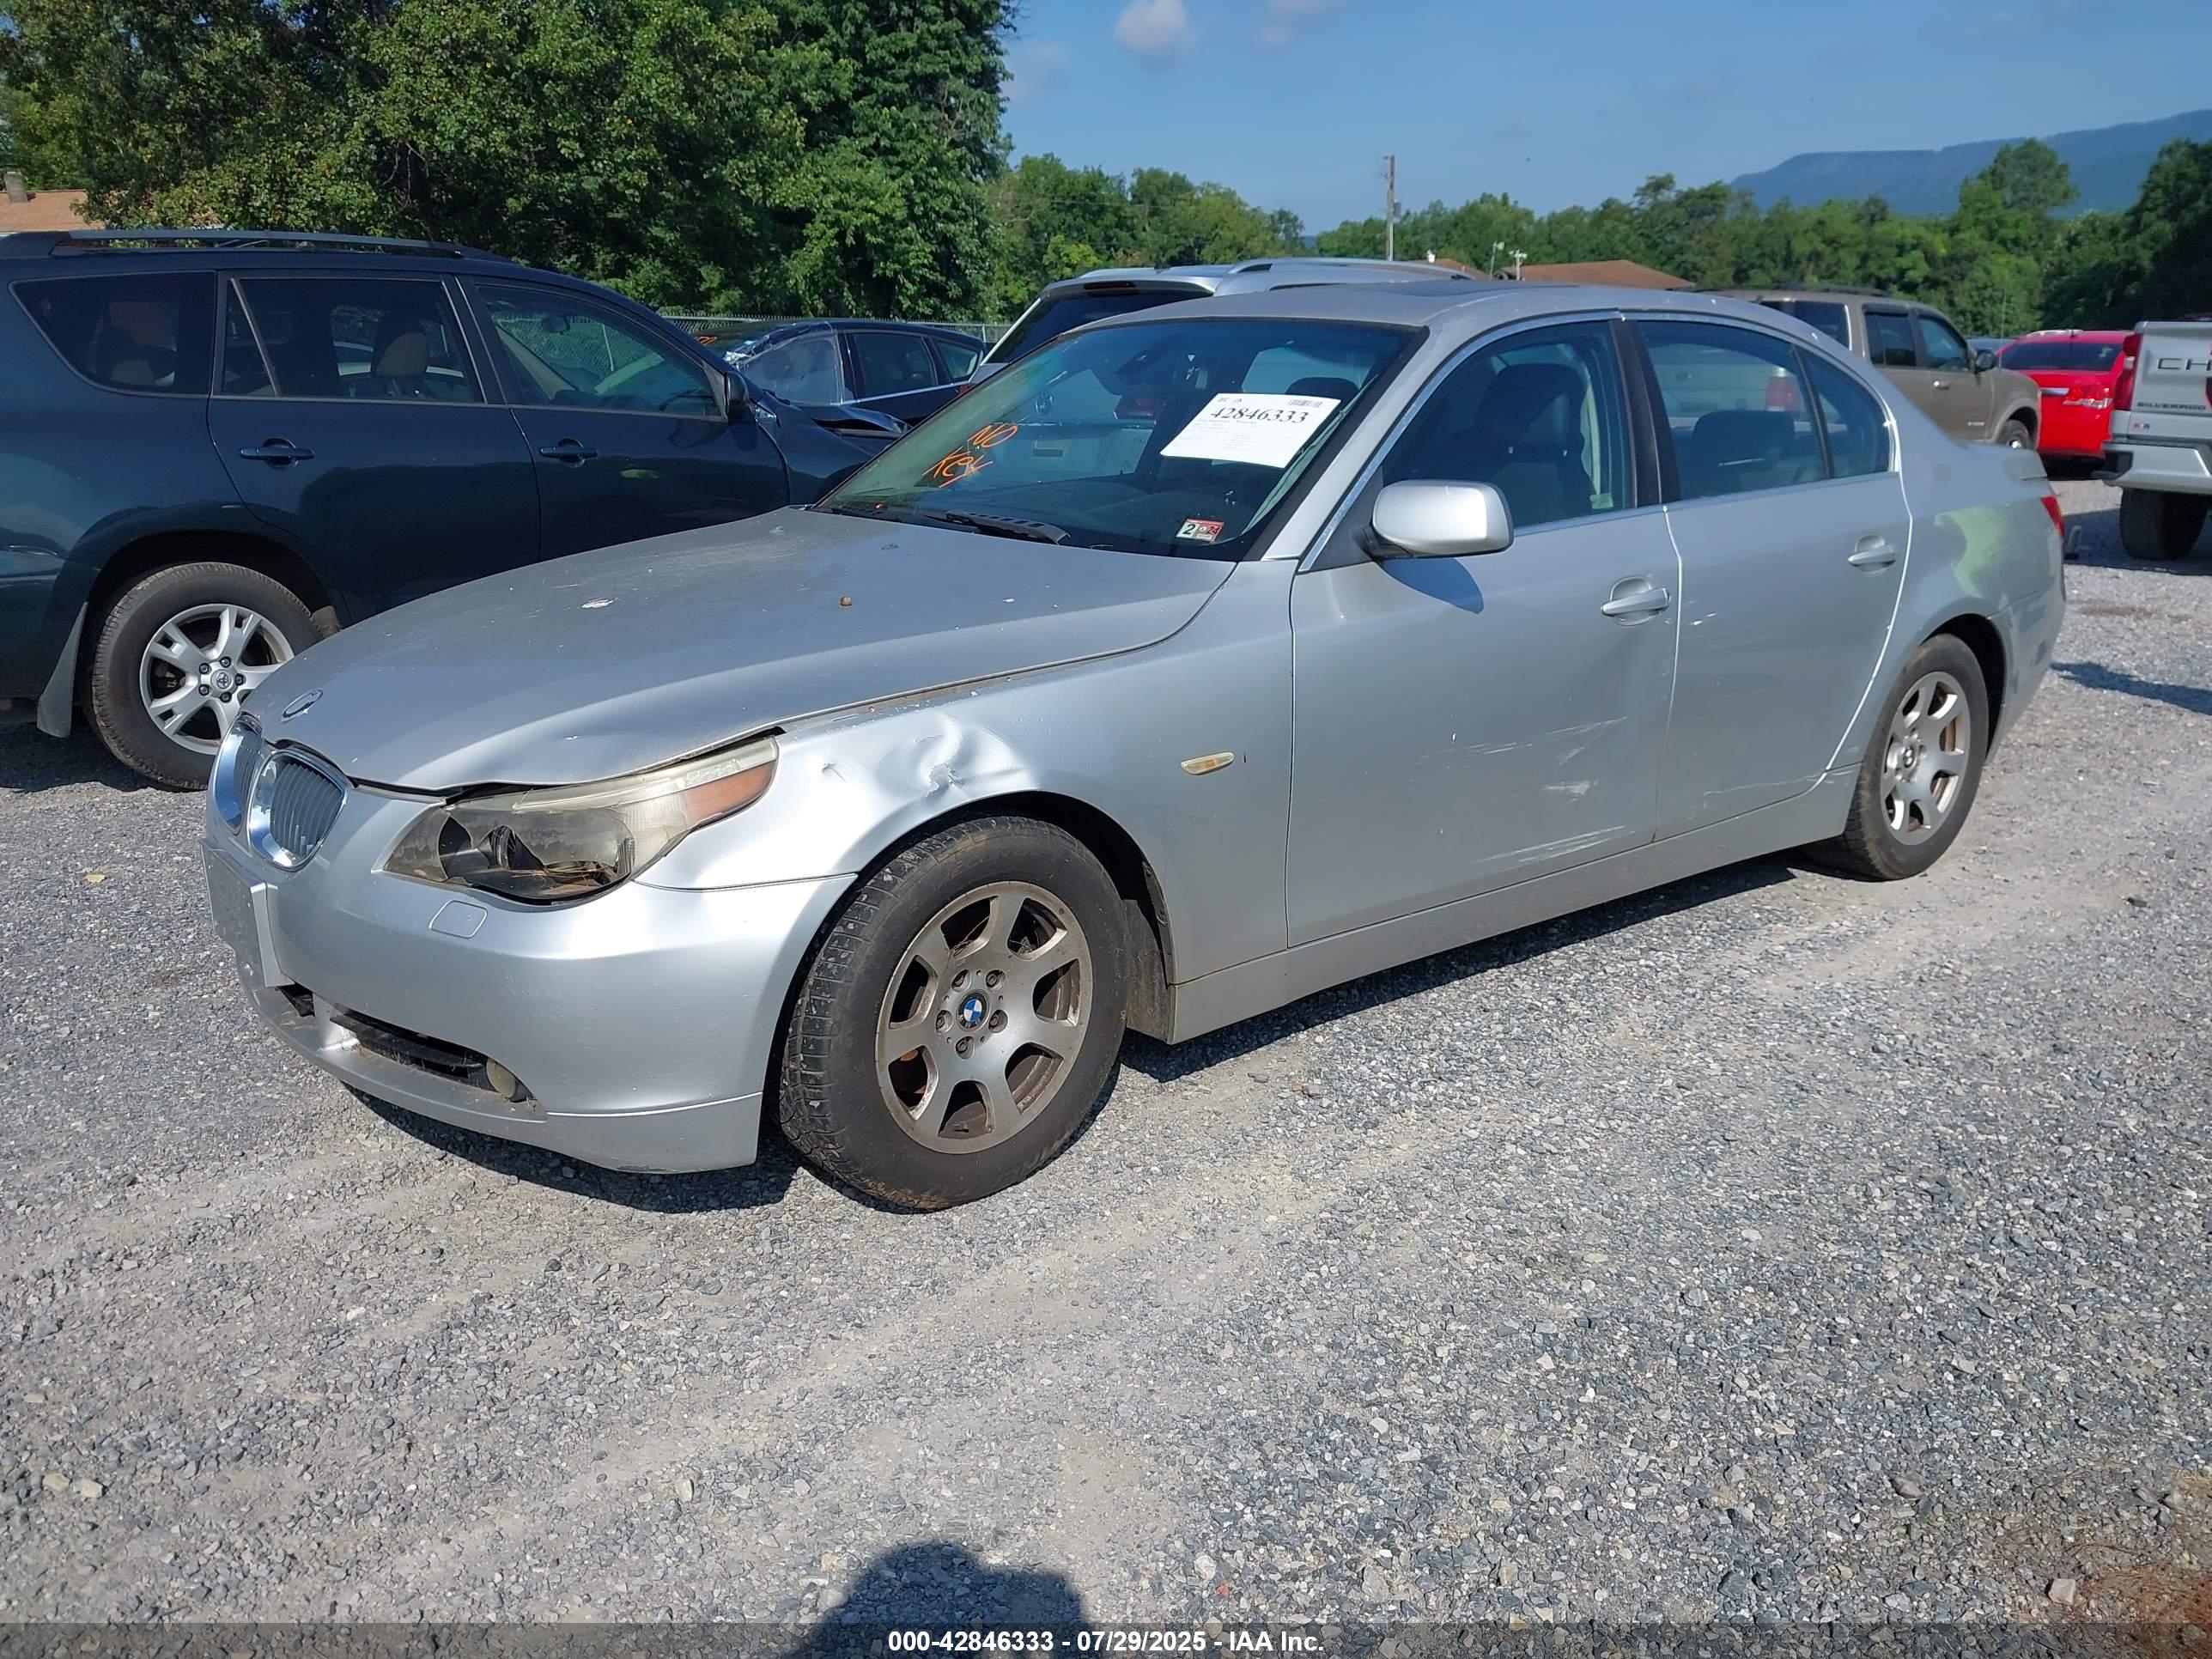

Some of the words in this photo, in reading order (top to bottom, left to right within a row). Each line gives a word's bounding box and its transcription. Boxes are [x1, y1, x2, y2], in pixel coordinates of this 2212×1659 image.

[2137, 402, 2206, 410] SILVERADO
[1211, 407, 1310, 423] 42846333
[968, 422, 1018, 448] NO
[1182, 524, 1196, 534] 2
